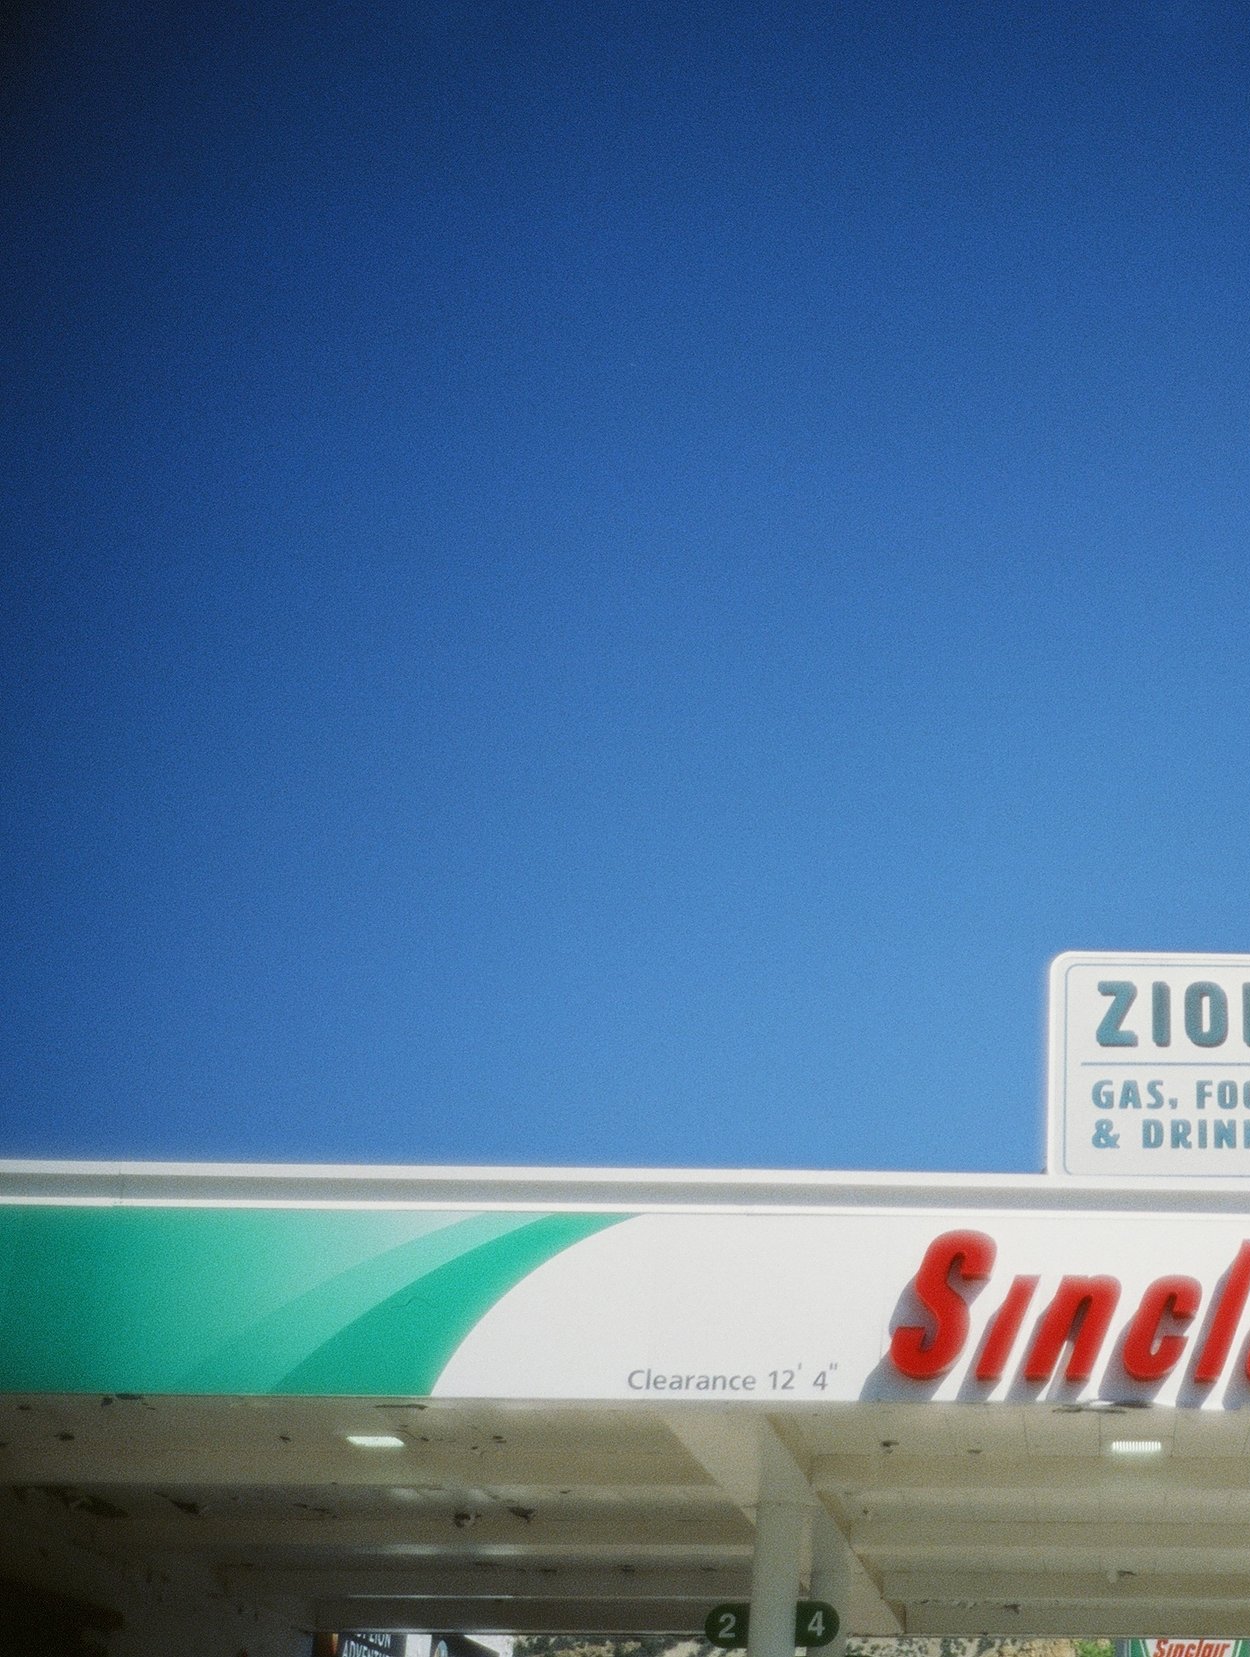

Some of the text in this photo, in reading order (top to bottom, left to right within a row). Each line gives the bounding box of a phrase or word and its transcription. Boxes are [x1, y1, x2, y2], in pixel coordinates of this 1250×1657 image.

[1091, 1079, 1178, 1110] GAS,
[1091, 1118, 1120, 1150] &
[627, 1369, 756, 1390] Clearance
[718, 1612, 736, 1638] 2
[807, 1610, 825, 1637] 4
[1152, 1638, 1230, 1657] Sinclair
